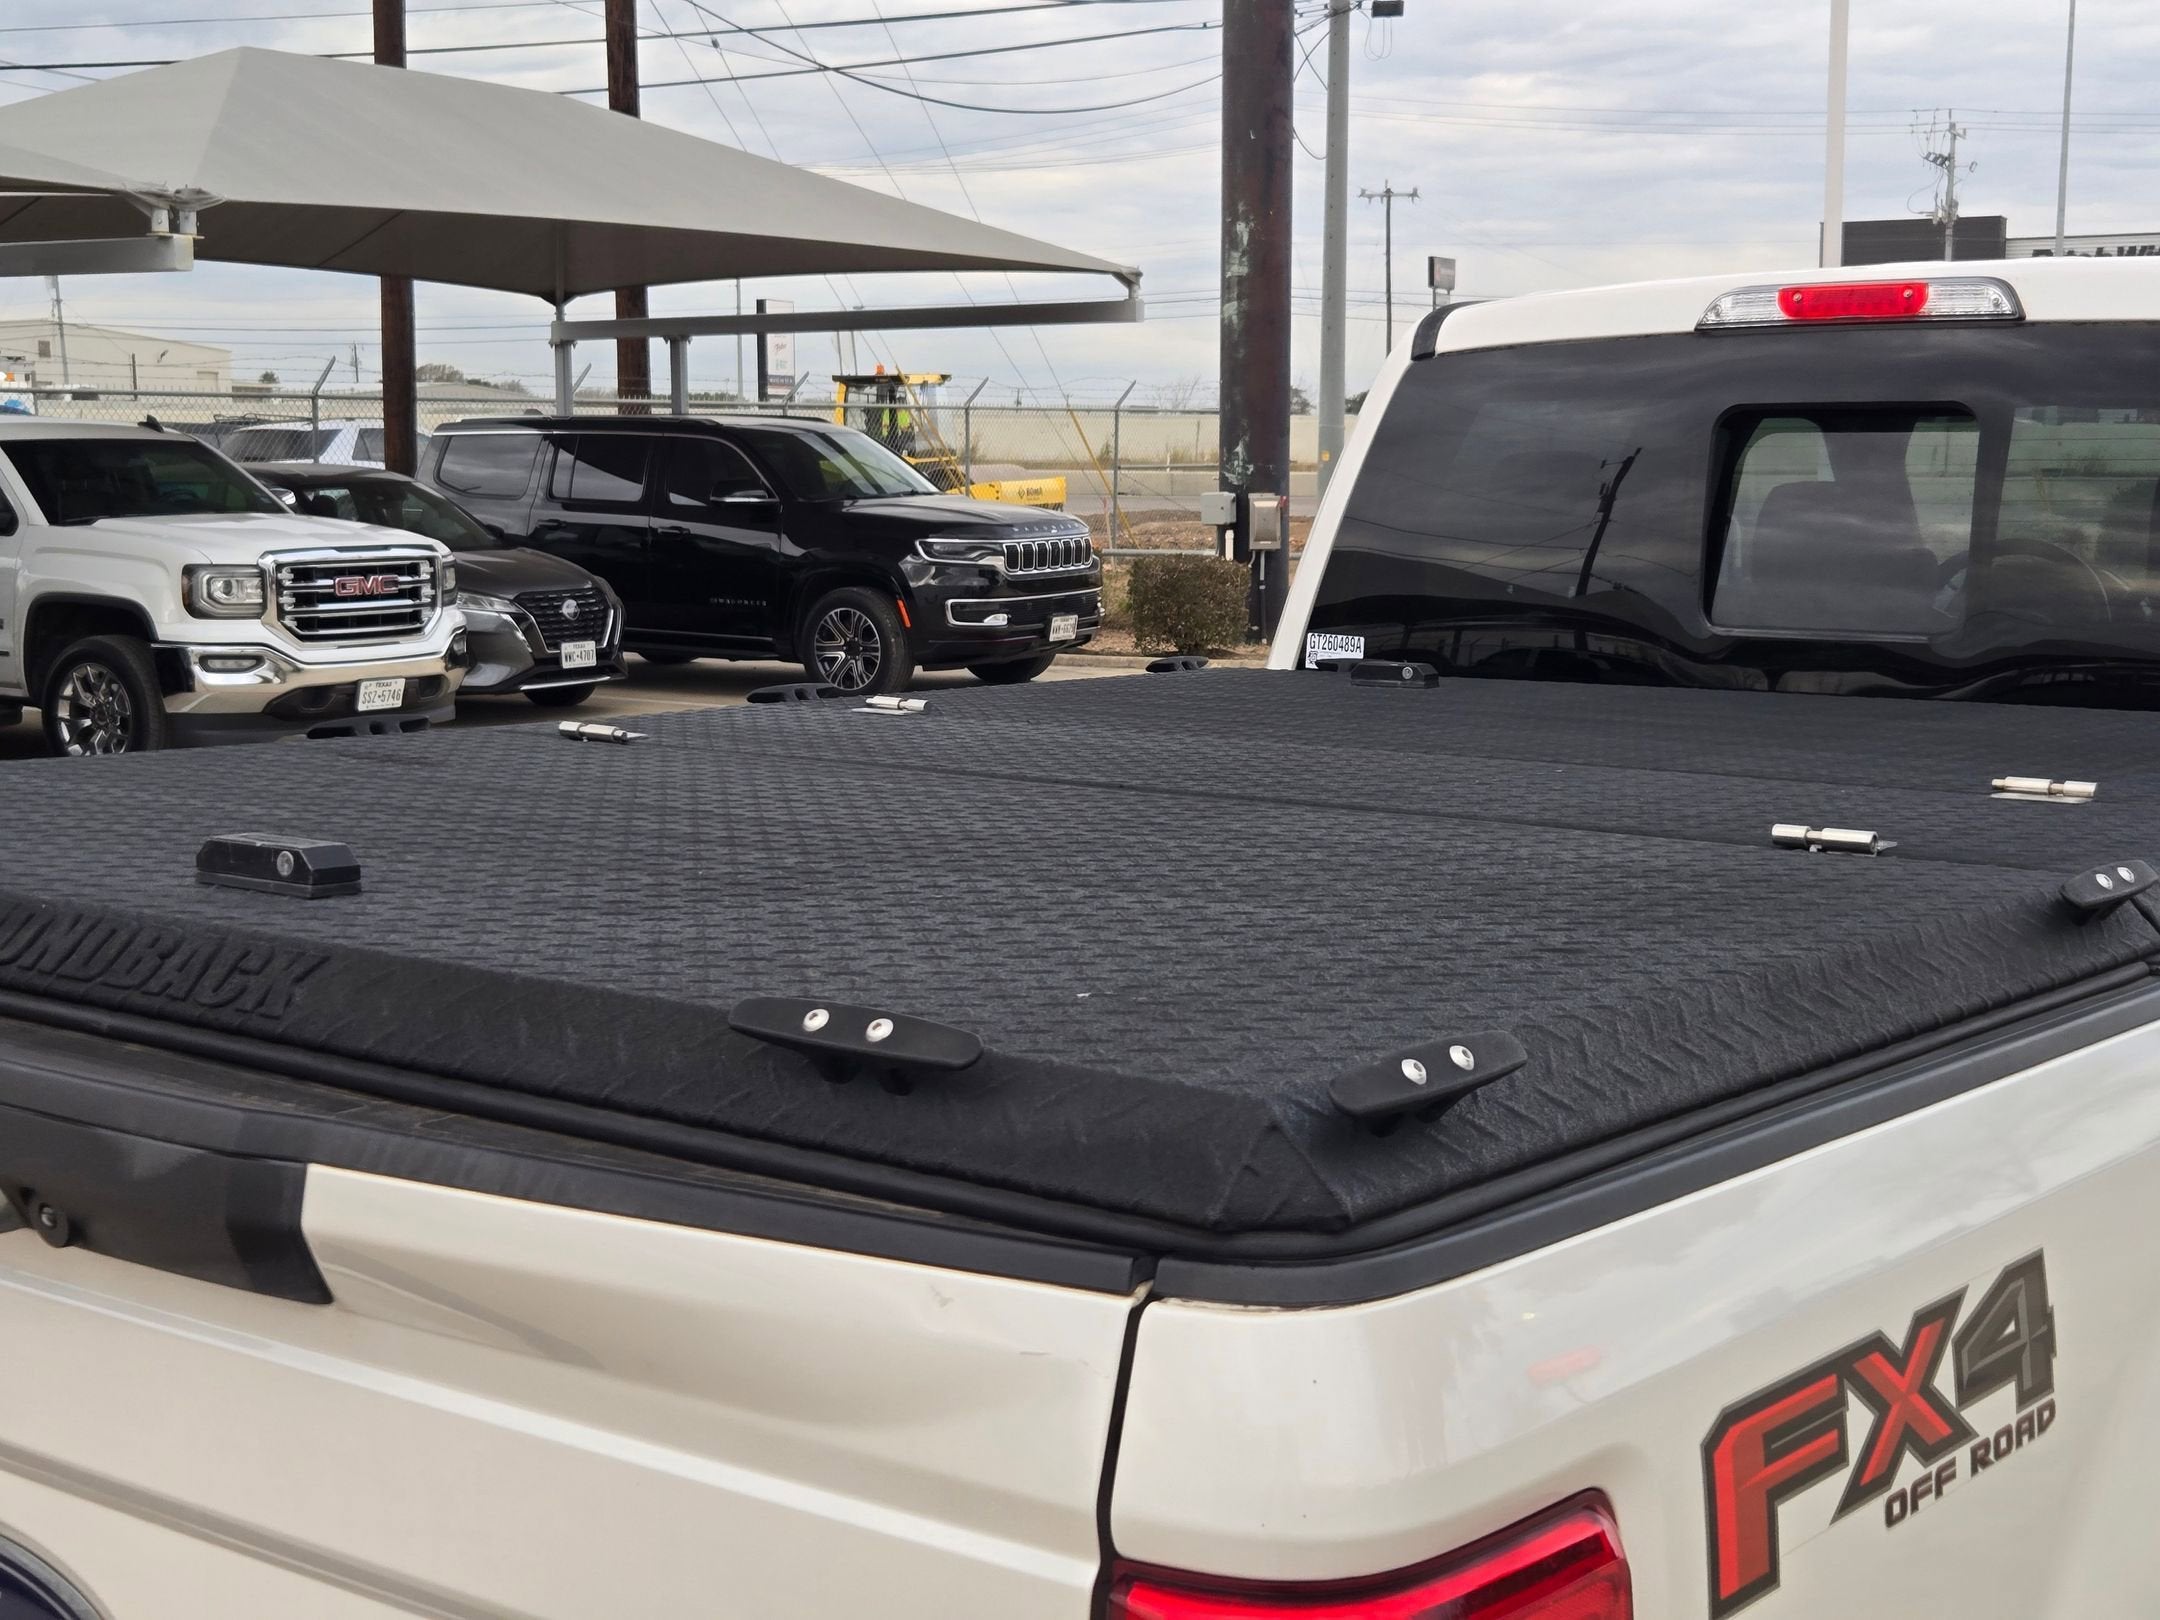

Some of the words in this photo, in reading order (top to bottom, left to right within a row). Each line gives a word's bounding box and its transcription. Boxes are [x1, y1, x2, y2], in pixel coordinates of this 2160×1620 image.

[335, 575, 399, 596] GMC
[1309, 633, 1362, 654] GT260489A
[0, 902, 332, 1021] ONDBACK
[1700, 1247, 2057, 1620] FX4
[1884, 1456, 1957, 1529] OFF
[1970, 1397, 2057, 1480] ROAD
